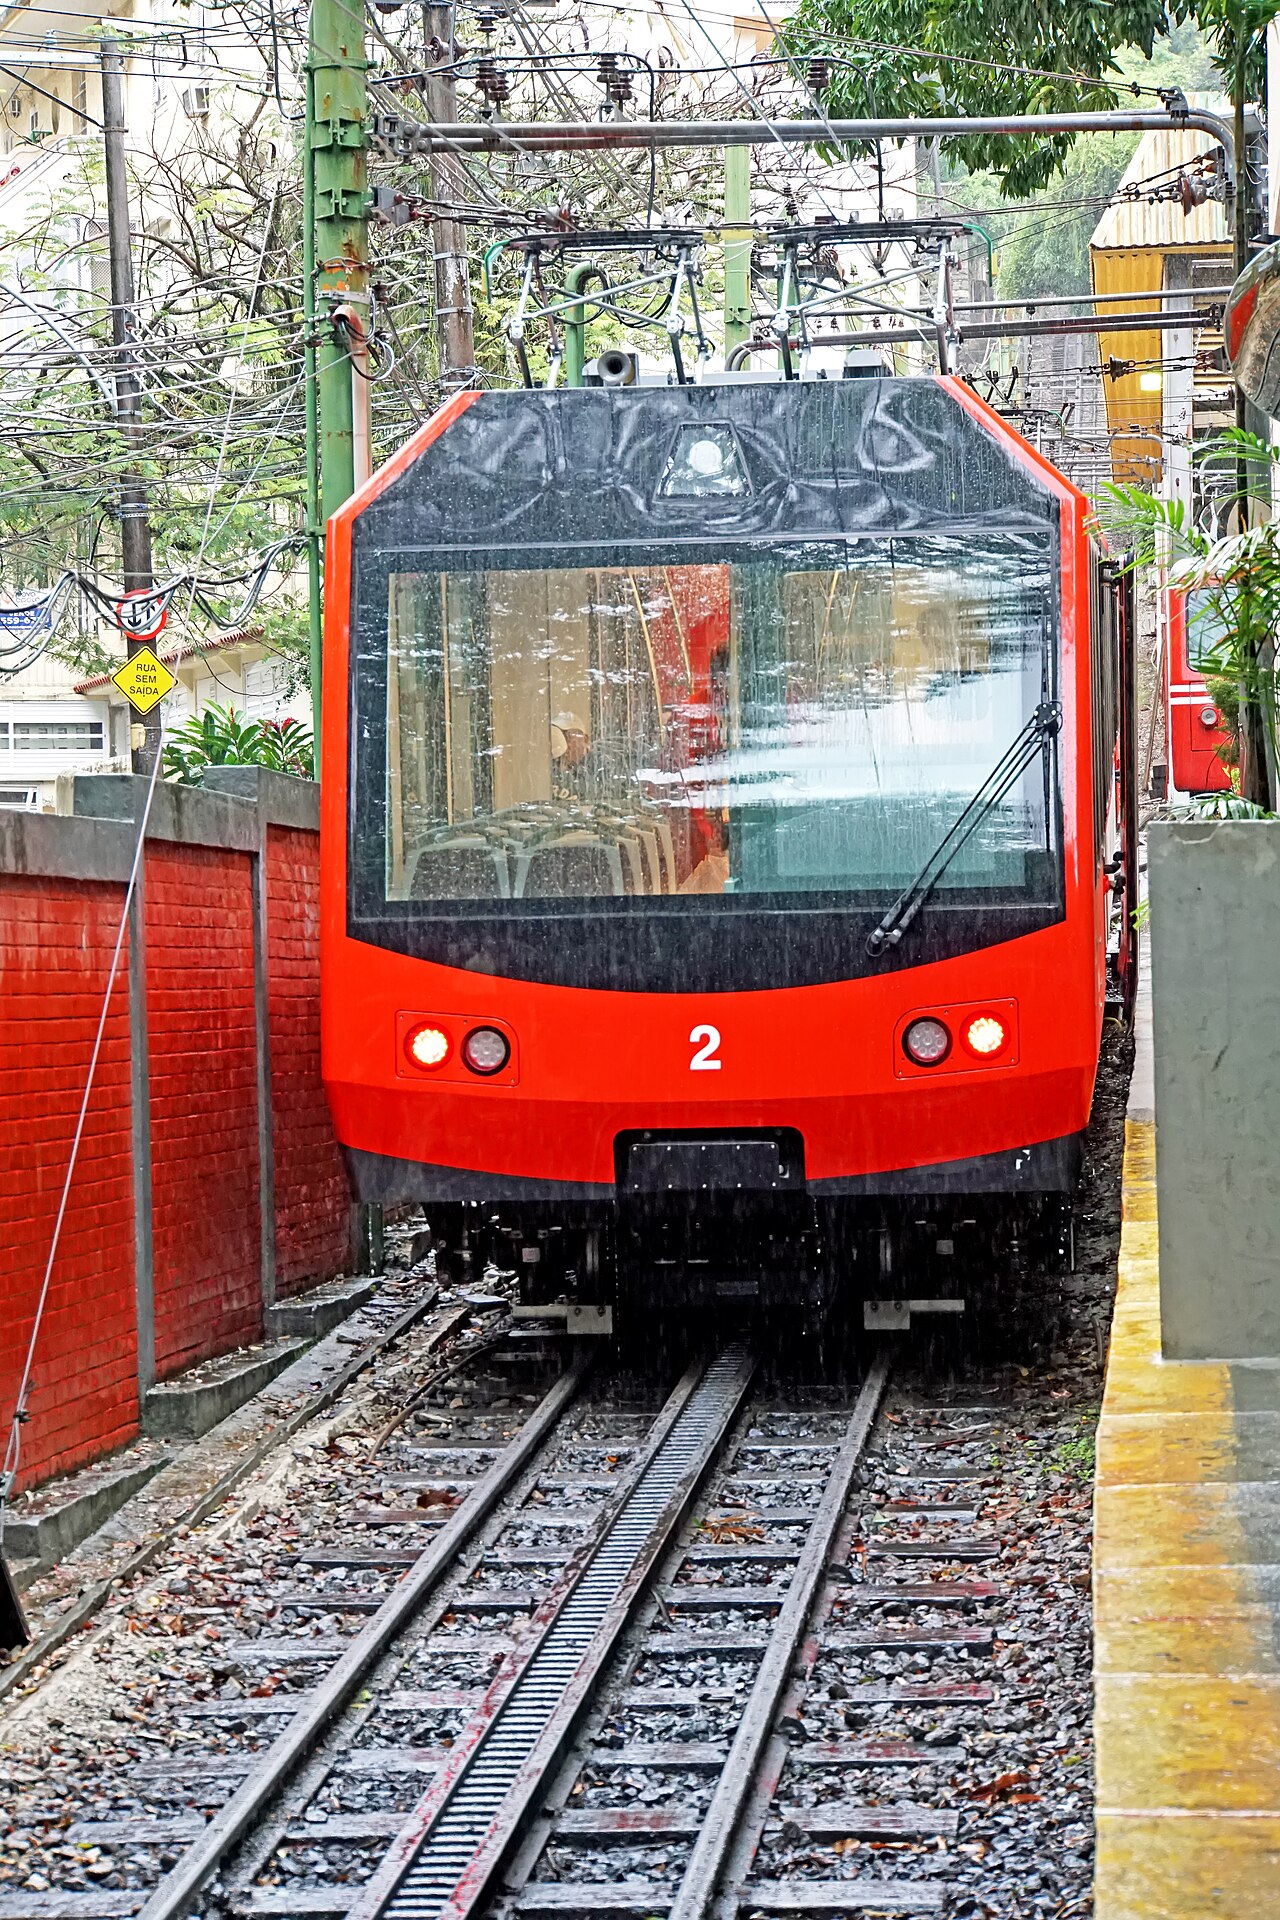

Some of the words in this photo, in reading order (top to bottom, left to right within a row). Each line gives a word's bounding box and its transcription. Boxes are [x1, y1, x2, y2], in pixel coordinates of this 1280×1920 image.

[136, 663, 157, 672] RUA
[135, 674, 157, 683] SEM
[689, 1024, 722, 1070] 2
